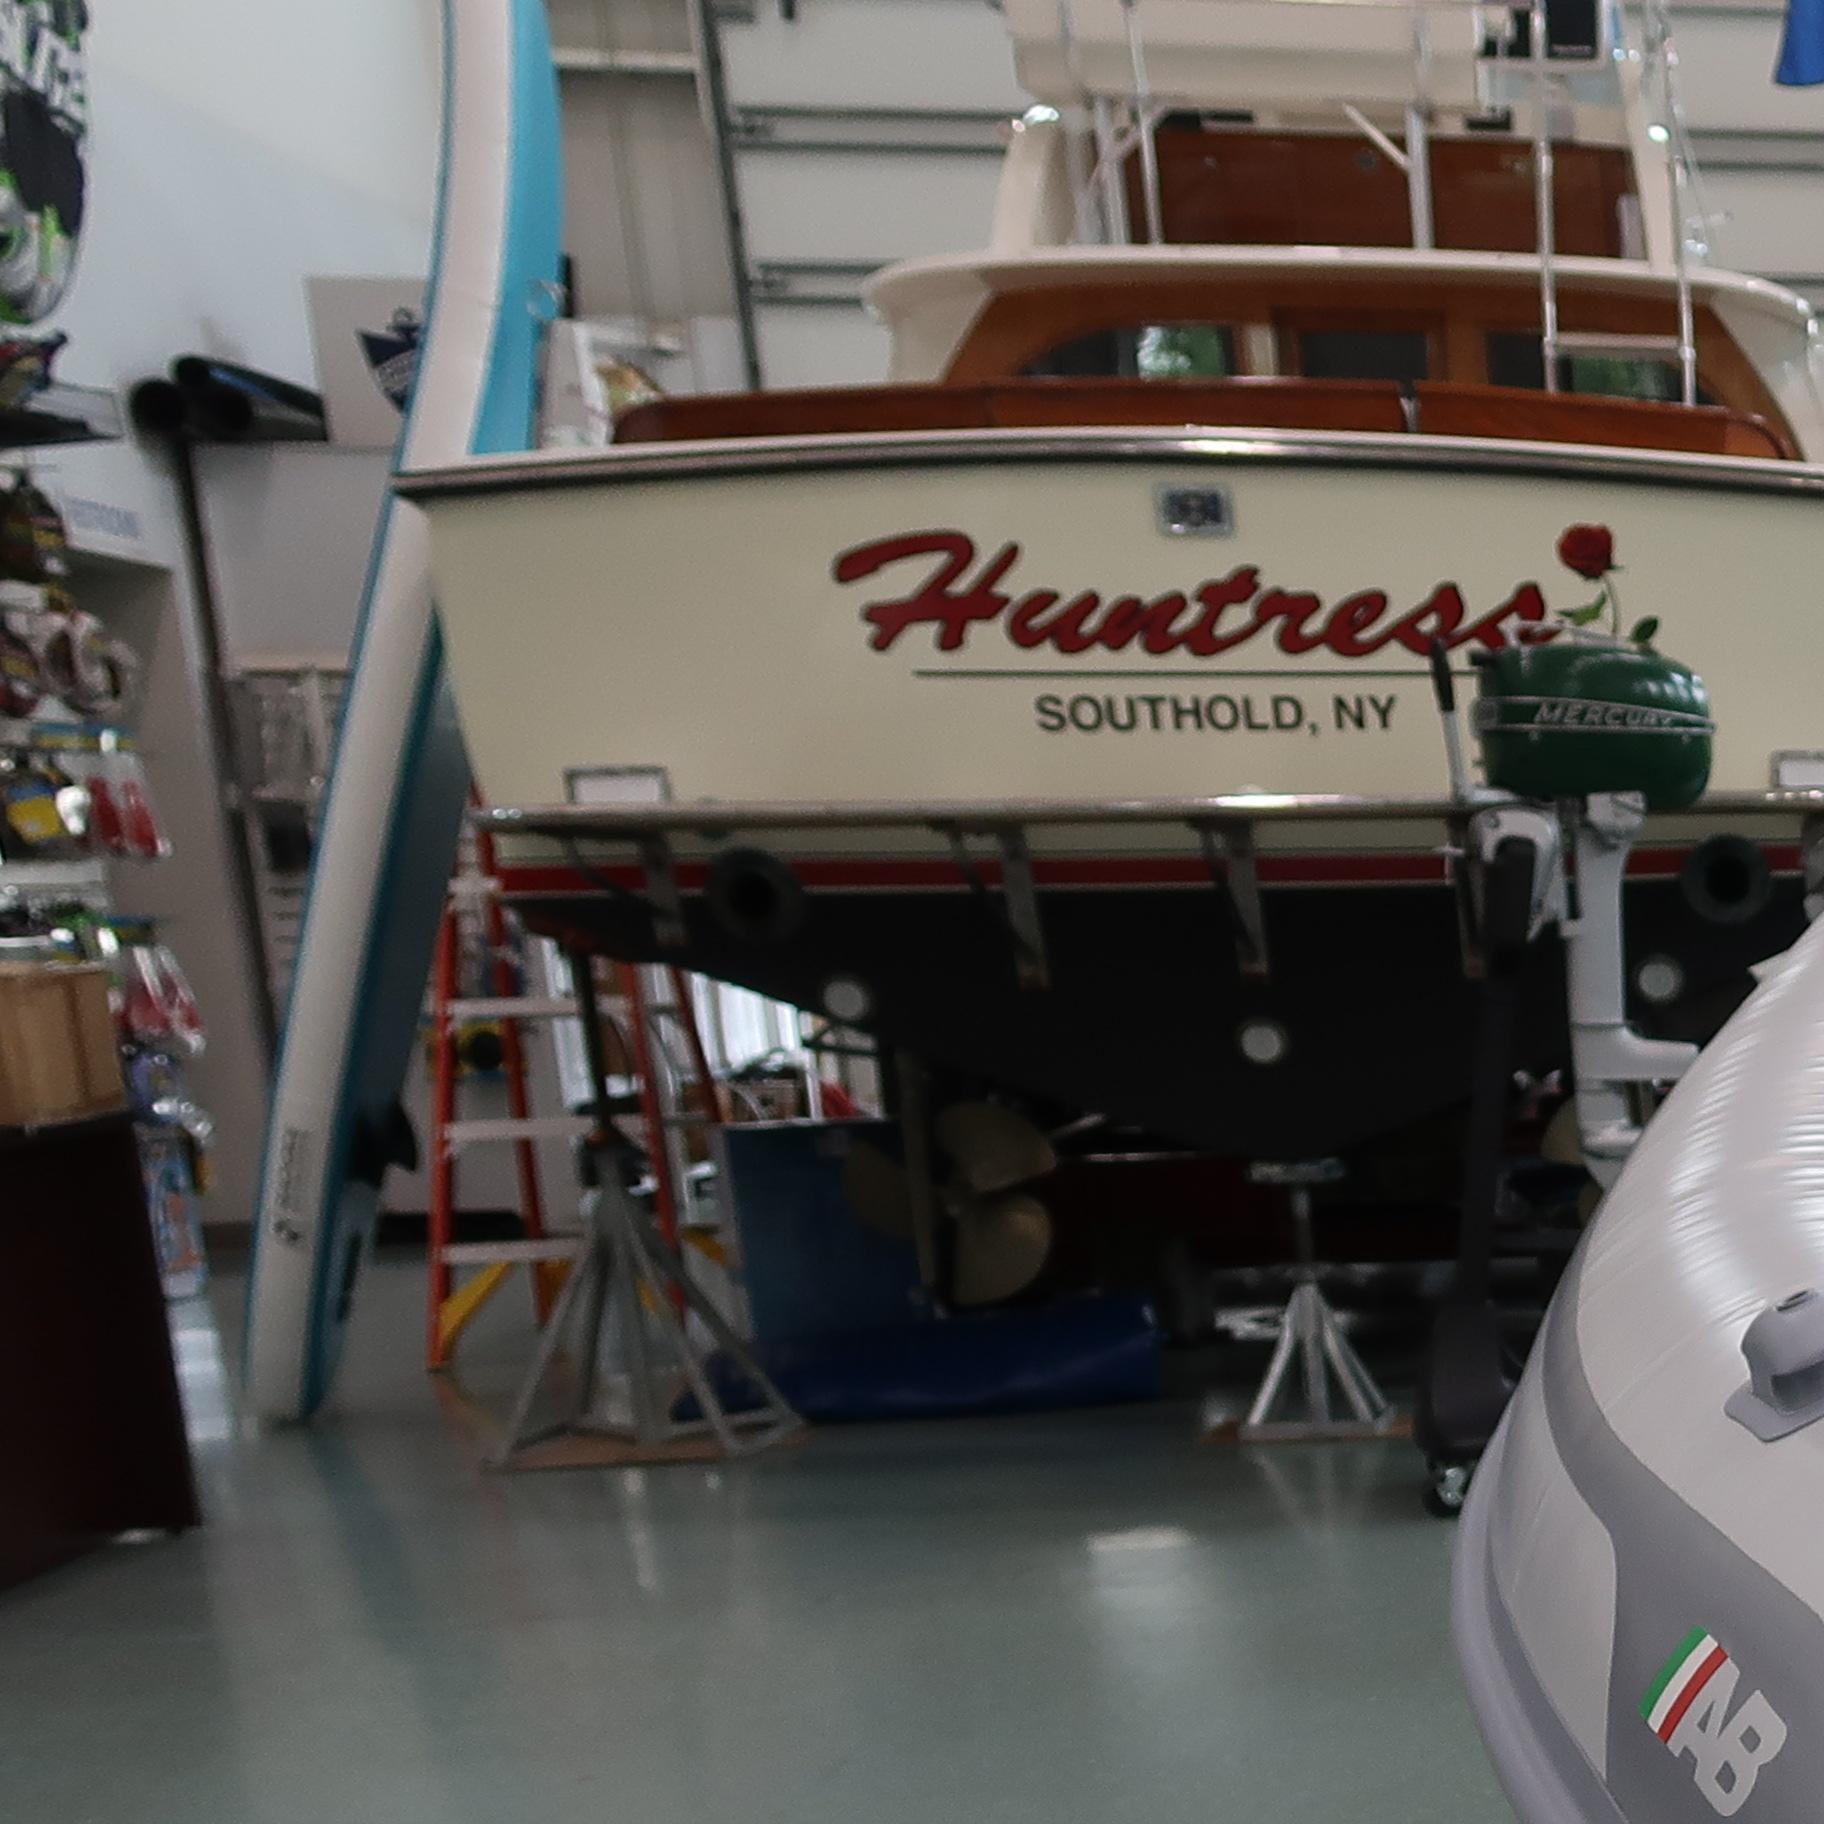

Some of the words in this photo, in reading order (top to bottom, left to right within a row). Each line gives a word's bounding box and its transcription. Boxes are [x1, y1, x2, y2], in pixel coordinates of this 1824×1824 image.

[832, 527, 1561, 657] Huntress
[1036, 693, 1319, 737] SOUTHOLD,
[1333, 694, 1397, 731] NY
[1534, 701, 1673, 726] MERCURY
[1662, 1652, 1788, 1817] AB
